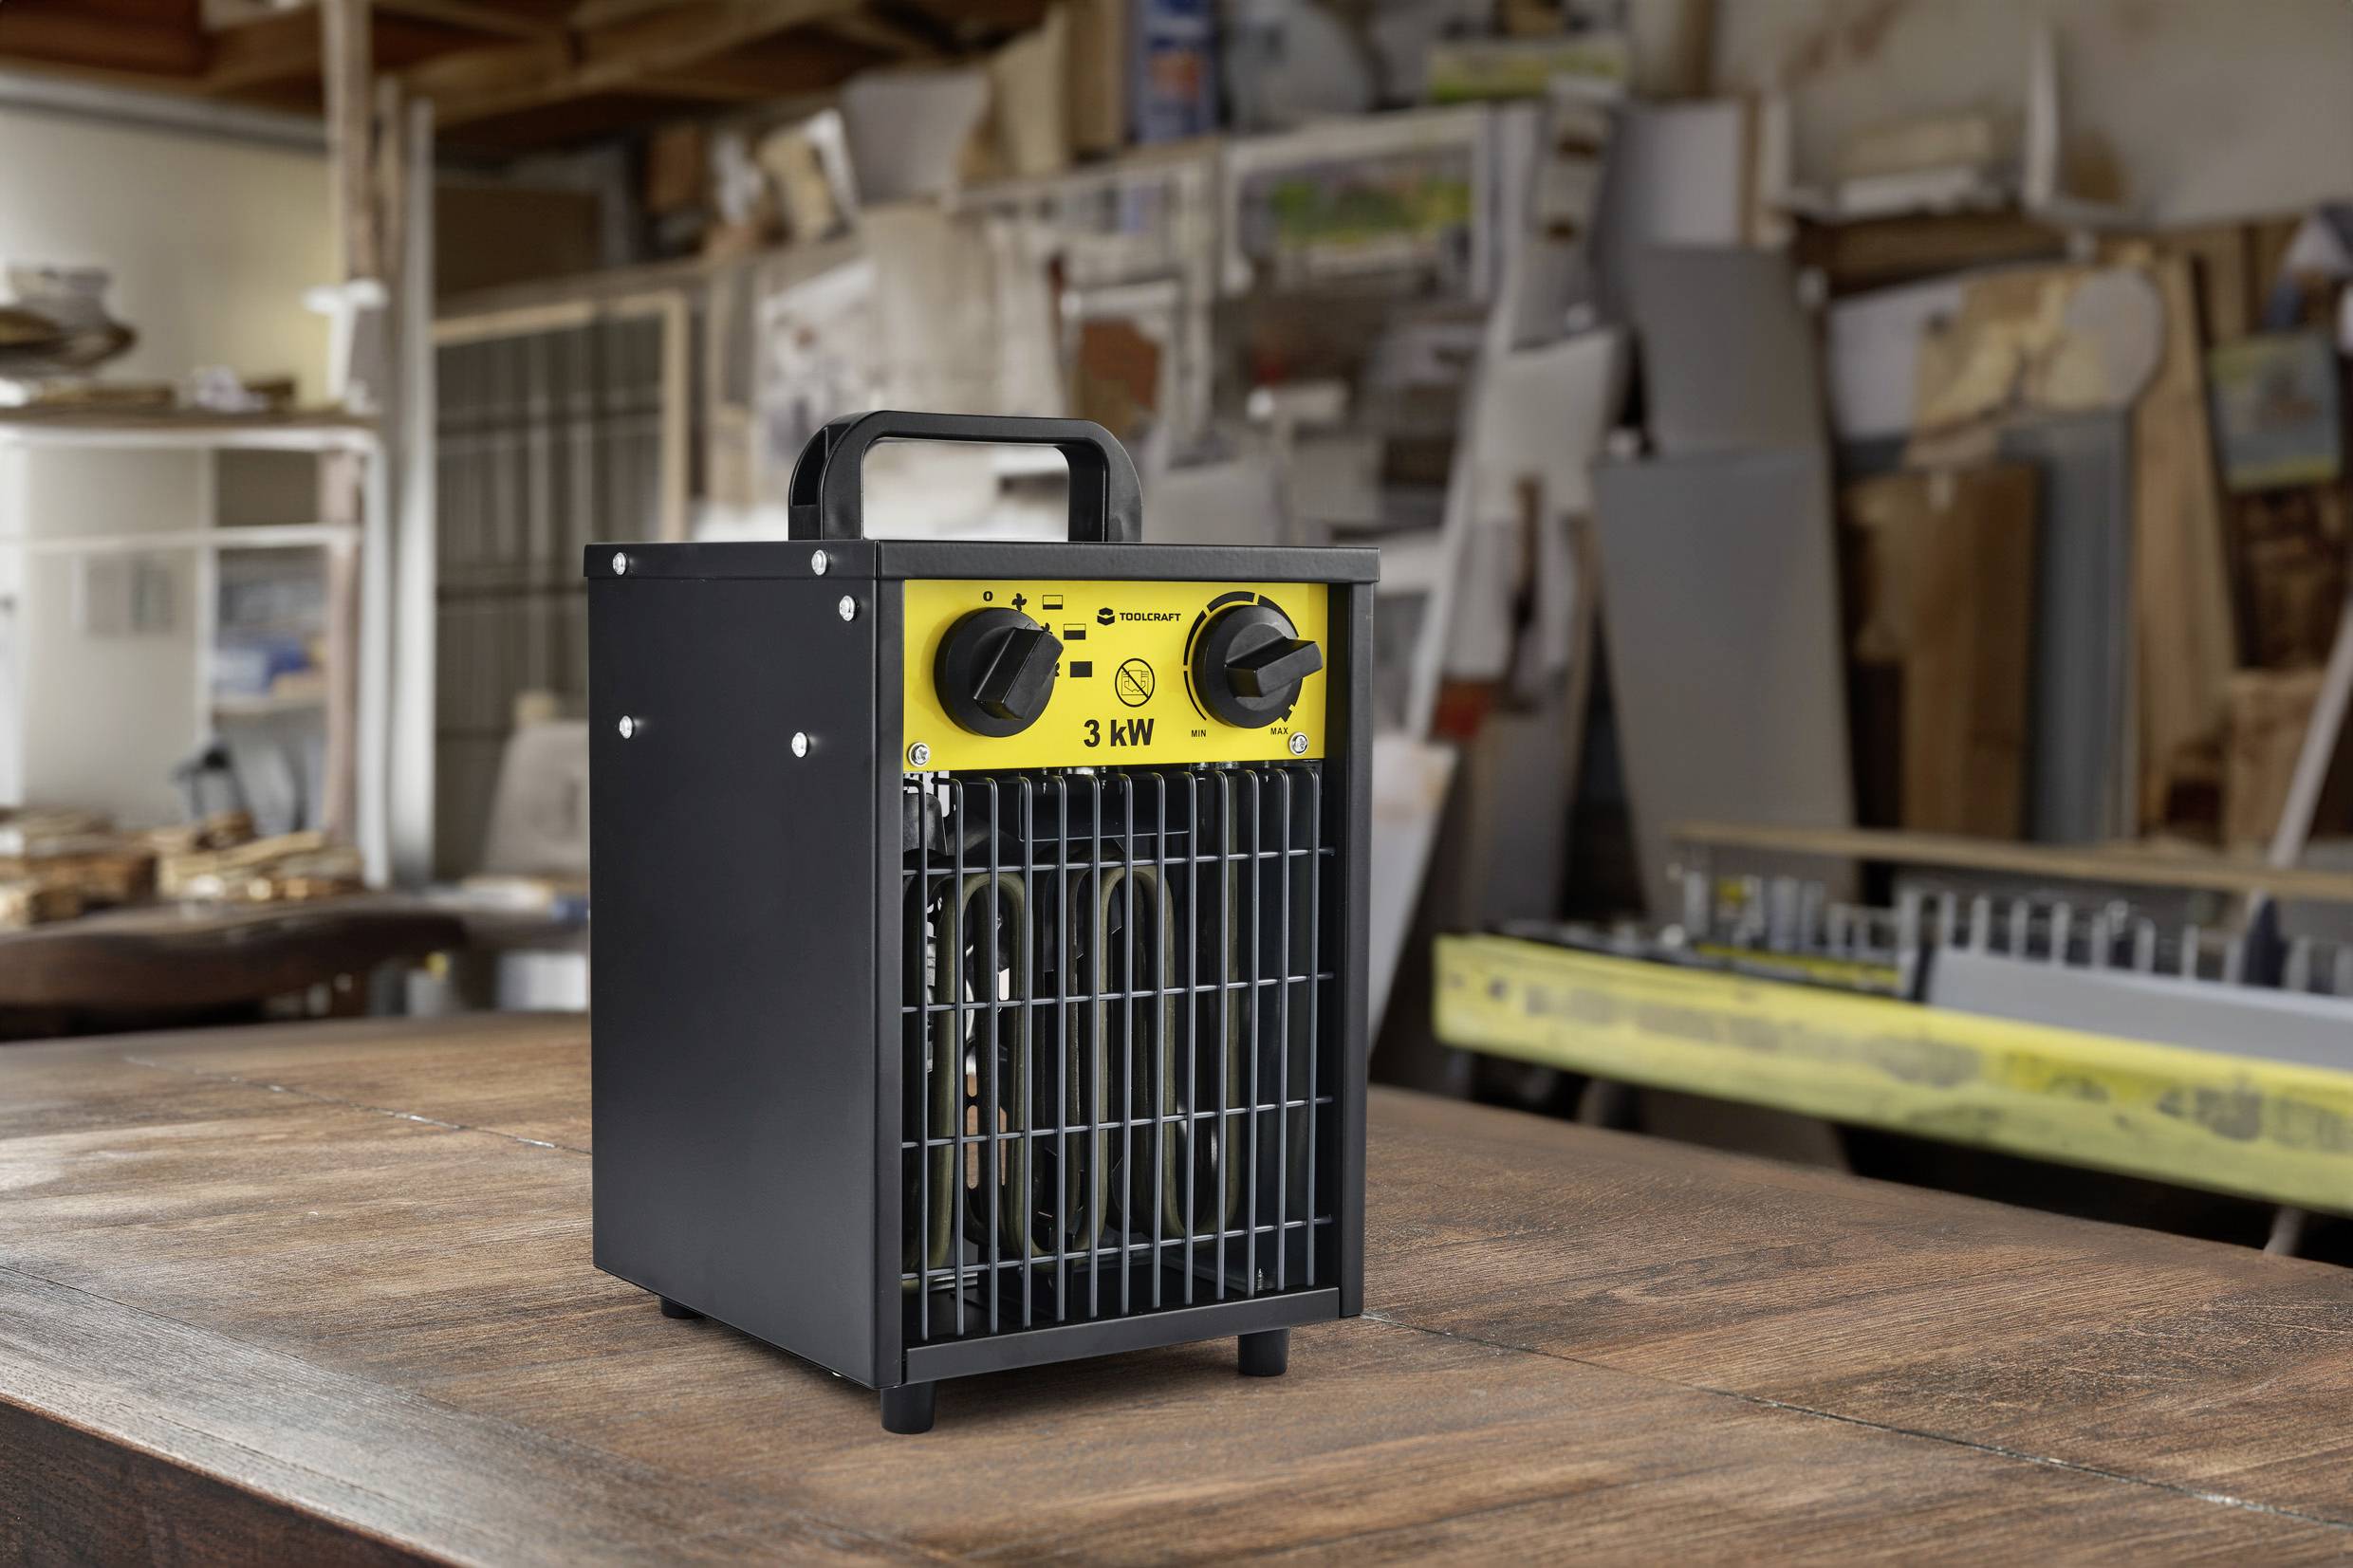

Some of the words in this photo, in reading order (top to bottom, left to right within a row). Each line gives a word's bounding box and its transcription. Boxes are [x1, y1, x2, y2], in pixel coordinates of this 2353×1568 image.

[1119, 612, 1182, 622] TOOLCRAFT
[1083, 719, 1101, 748] 3
[1110, 718, 1155, 747] kW
[1191, 729, 1207, 738] MIN
[1269, 727, 1288, 736] MAX
